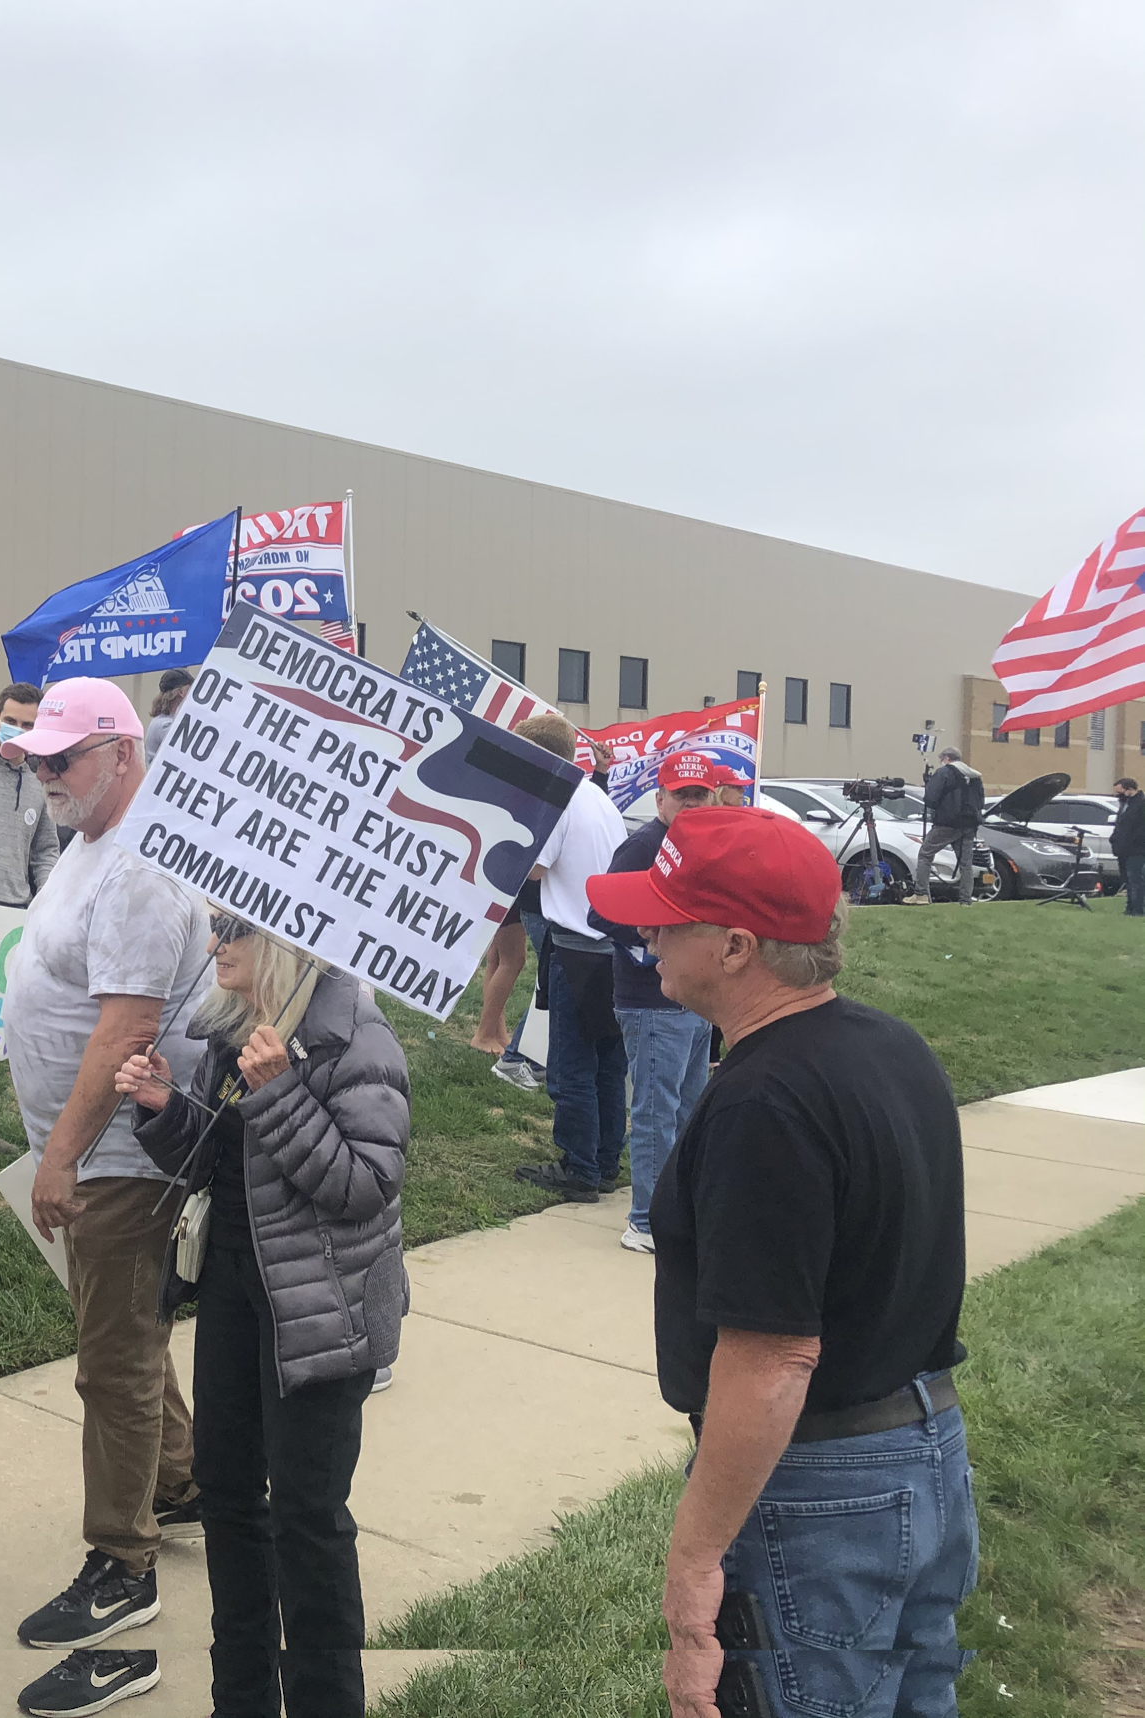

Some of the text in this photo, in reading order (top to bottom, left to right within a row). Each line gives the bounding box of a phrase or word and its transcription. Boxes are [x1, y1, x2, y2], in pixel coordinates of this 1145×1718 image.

[191, 668, 402, 799] OF THE PAST
[238, 621, 444, 744] DEMOCRATS
[169, 713, 459, 887] NO LONGER EXIST
[673, 763, 709, 773] AMERICA
[678, 770, 705, 779] GREAT
[139, 822, 464, 1014] COMMUNIST TODAY
[152, 760, 474, 951] THEY ARE THE NEW
[290, 1036, 308, 1060] TRUMP
